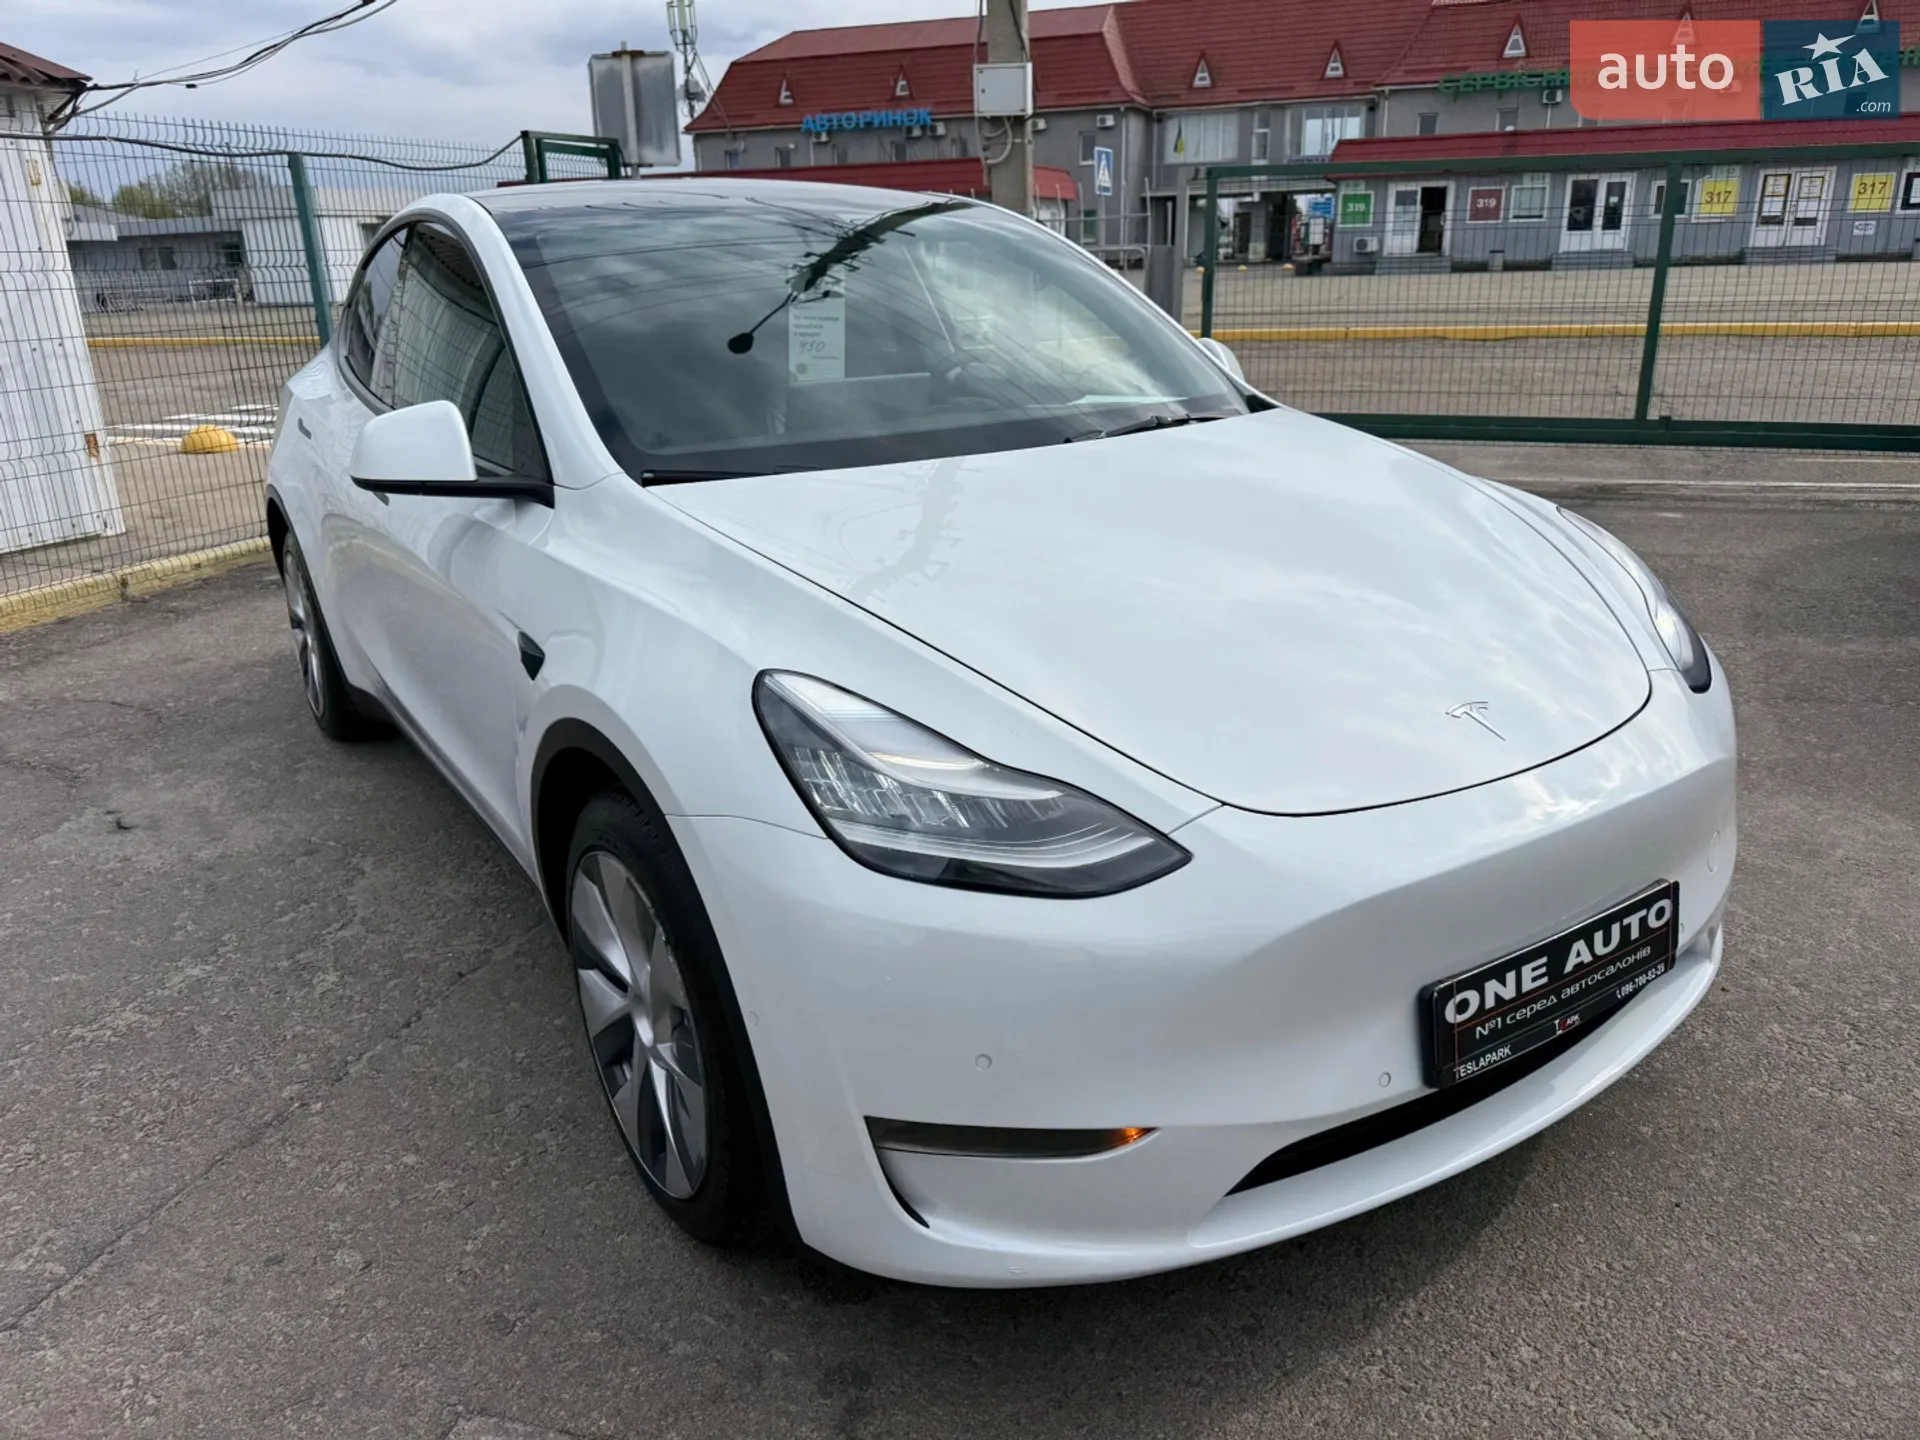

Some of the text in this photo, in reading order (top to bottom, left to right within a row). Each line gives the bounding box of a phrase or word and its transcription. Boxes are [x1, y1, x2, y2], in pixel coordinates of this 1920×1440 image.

[800, 108, 933, 133] АВТОРИНОК
[1705, 190, 1733, 204] 317
[1858, 181, 1888, 195] 317
[1346, 202, 1366, 212] 319
[1475, 197, 1498, 208] 319
[1444, 898, 1674, 1024] ONE AUTO
[1506, 995, 1558, 1025] серед
[1560, 945, 1652, 1000] автосалонів
[1453, 1044, 1512, 1080] TESLAPARK
